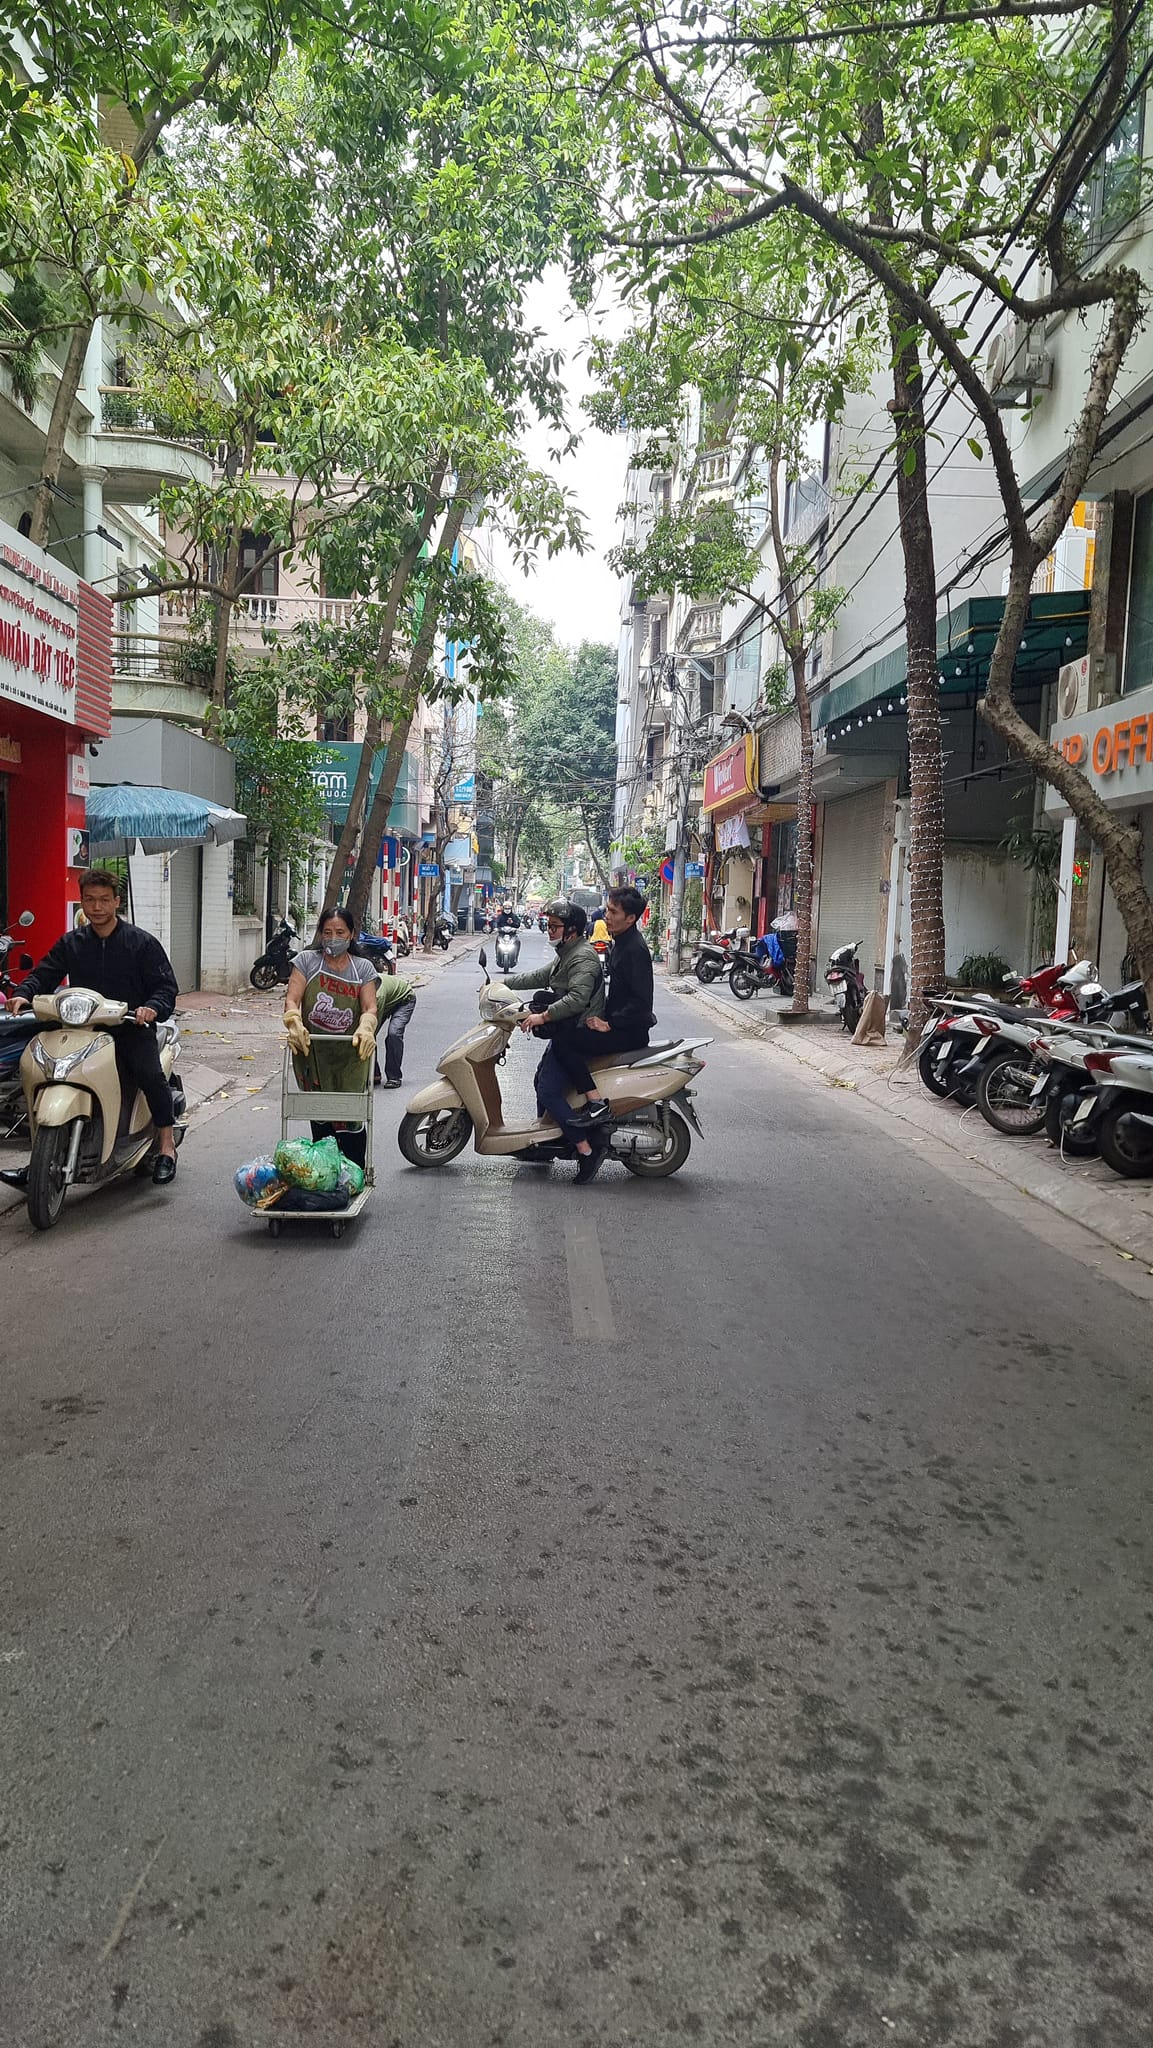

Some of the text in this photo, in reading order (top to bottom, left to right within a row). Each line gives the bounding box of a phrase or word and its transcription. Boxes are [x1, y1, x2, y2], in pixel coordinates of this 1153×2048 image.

[36, 607, 52, 625] CHỨC
[0, 618, 75, 693] NHẬN ĐẶT TIỆC
